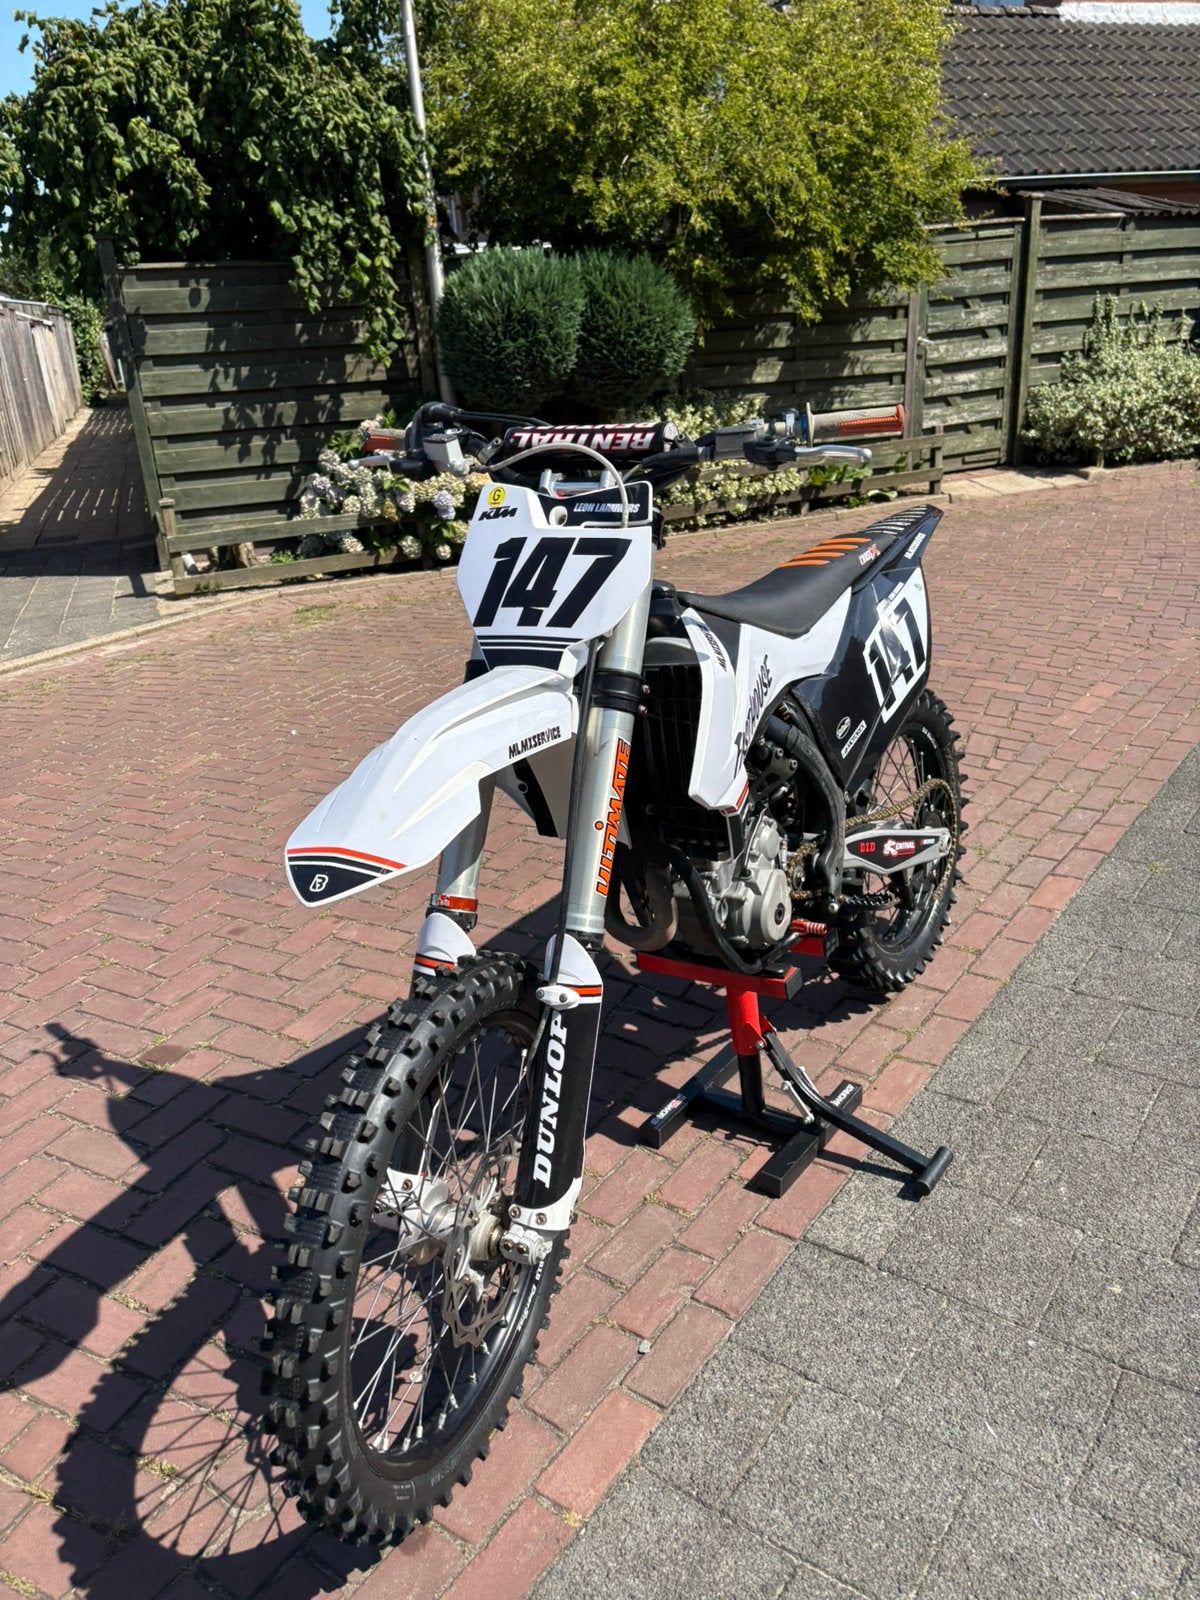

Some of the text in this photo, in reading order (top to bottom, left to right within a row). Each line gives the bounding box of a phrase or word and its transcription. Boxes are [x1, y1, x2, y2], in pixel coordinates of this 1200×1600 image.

[514, 432, 656, 450] RENTHAL
[492, 488, 502, 501] G
[478, 505, 518, 521] KTM
[573, 502, 641, 513] LEON LAMMRS
[473, 536, 632, 628] 147
[866, 596, 926, 712] 147
[532, 1010, 568, 1189] DUNLOP
